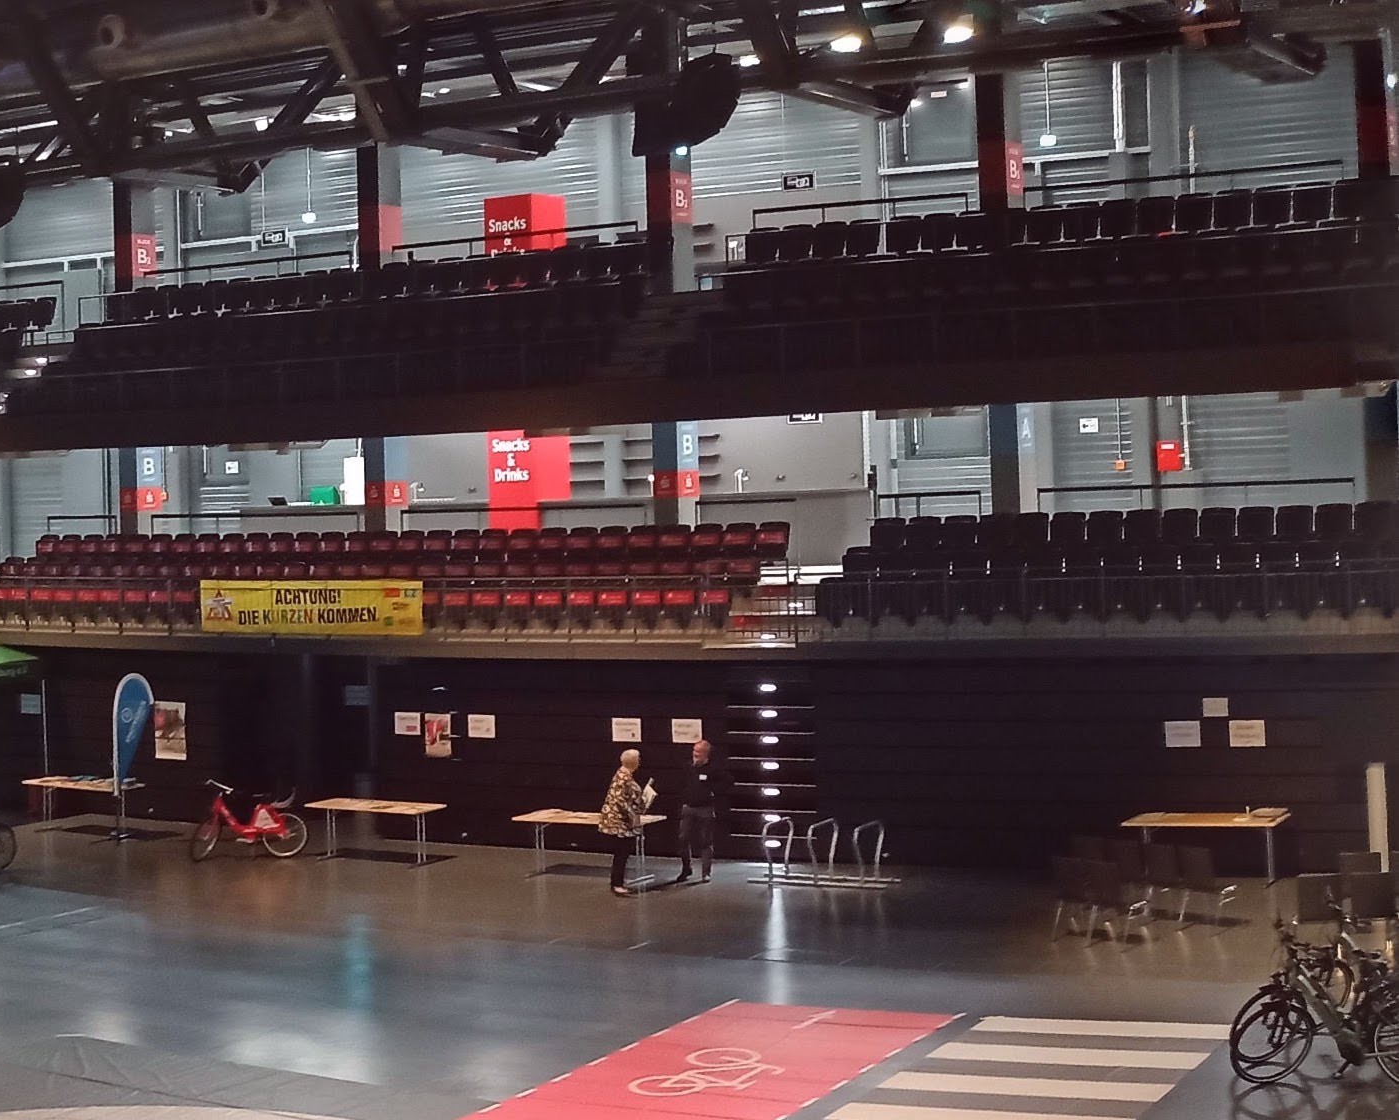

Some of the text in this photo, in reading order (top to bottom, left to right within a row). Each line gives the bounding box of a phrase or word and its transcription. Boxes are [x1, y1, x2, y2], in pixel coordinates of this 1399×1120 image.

[488, 216, 527, 233] Snacks
[137, 248, 152, 265] B2
[1021, 416, 1032, 439] A
[491, 437, 530, 453] Snacks
[682, 434, 693, 456] B
[143, 457, 155, 476] B
[506, 452, 516, 467] &
[494, 466, 530, 482] Drinks
[275, 588, 342, 606] ACHTUNG!
[238, 610, 259, 626] DIE
[263, 608, 313, 626] KURZEN
